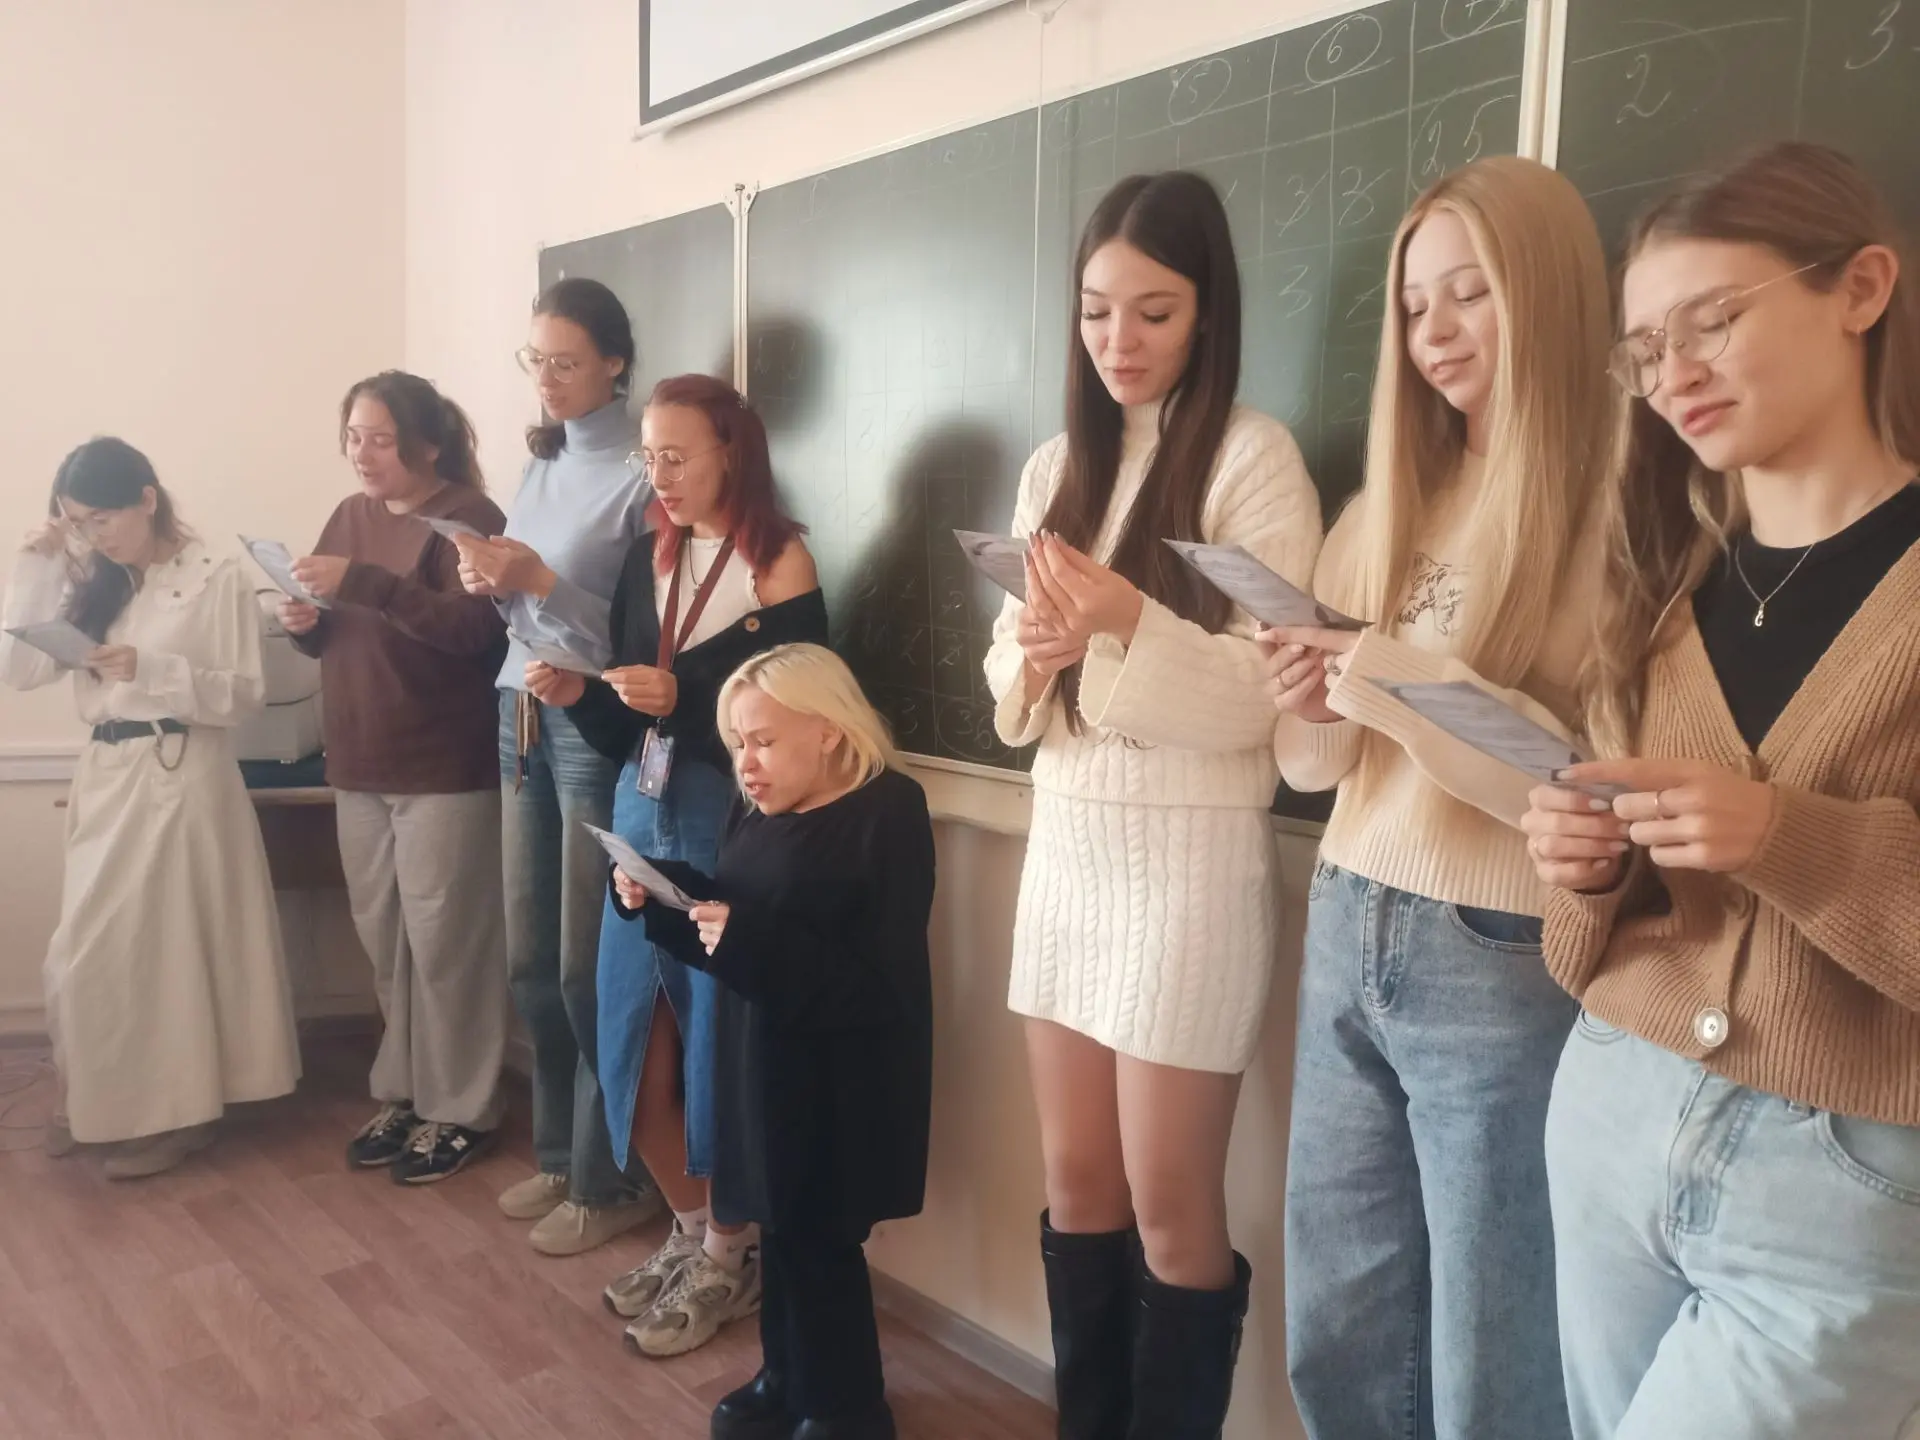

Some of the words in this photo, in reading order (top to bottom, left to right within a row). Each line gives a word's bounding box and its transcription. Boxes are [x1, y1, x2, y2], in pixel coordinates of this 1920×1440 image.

[1326, 23, 1349, 64] 6
[1845, 0, 1900, 69] 3
[1616, 53, 1662, 124] 2
